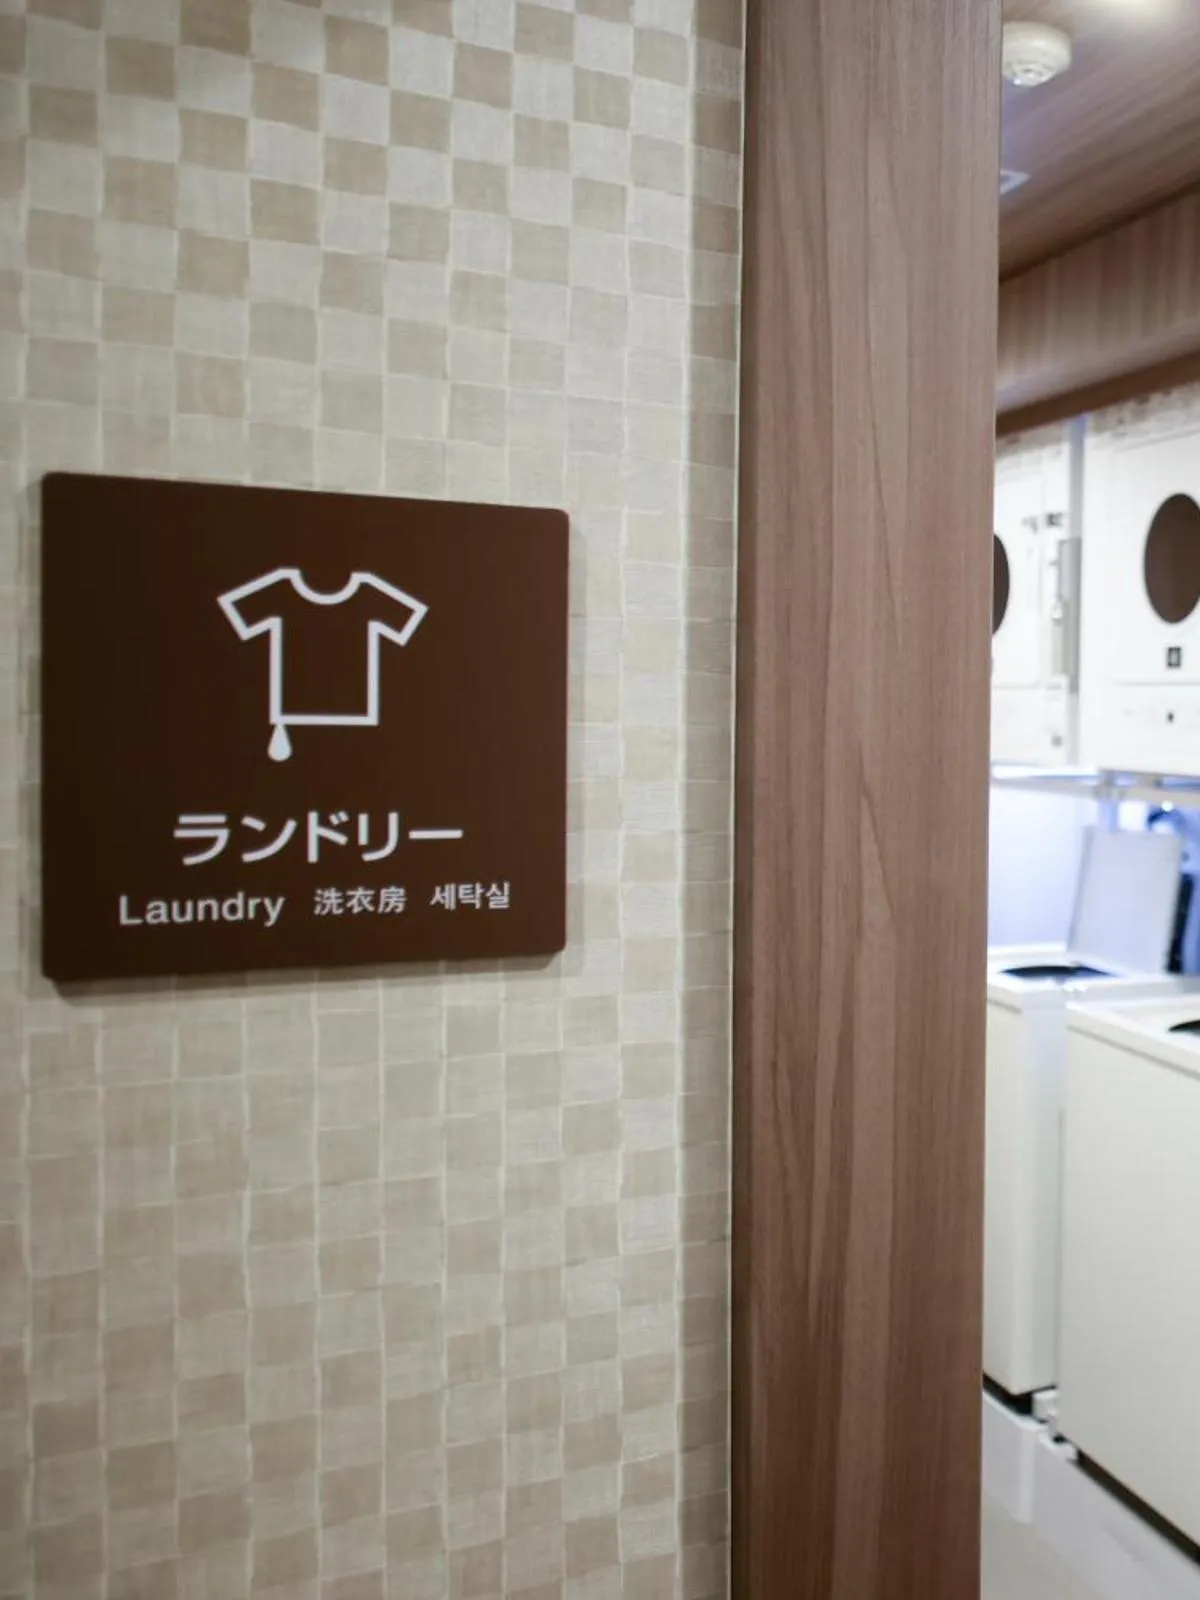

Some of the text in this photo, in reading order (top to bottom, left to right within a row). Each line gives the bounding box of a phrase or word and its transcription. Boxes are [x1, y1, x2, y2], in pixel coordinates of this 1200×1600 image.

[175, 812, 462, 864] ランドリー
[121, 893, 284, 926] Laundry
[315, 887, 405, 914] 洗衣房
[431, 883, 509, 909] 세탁실
